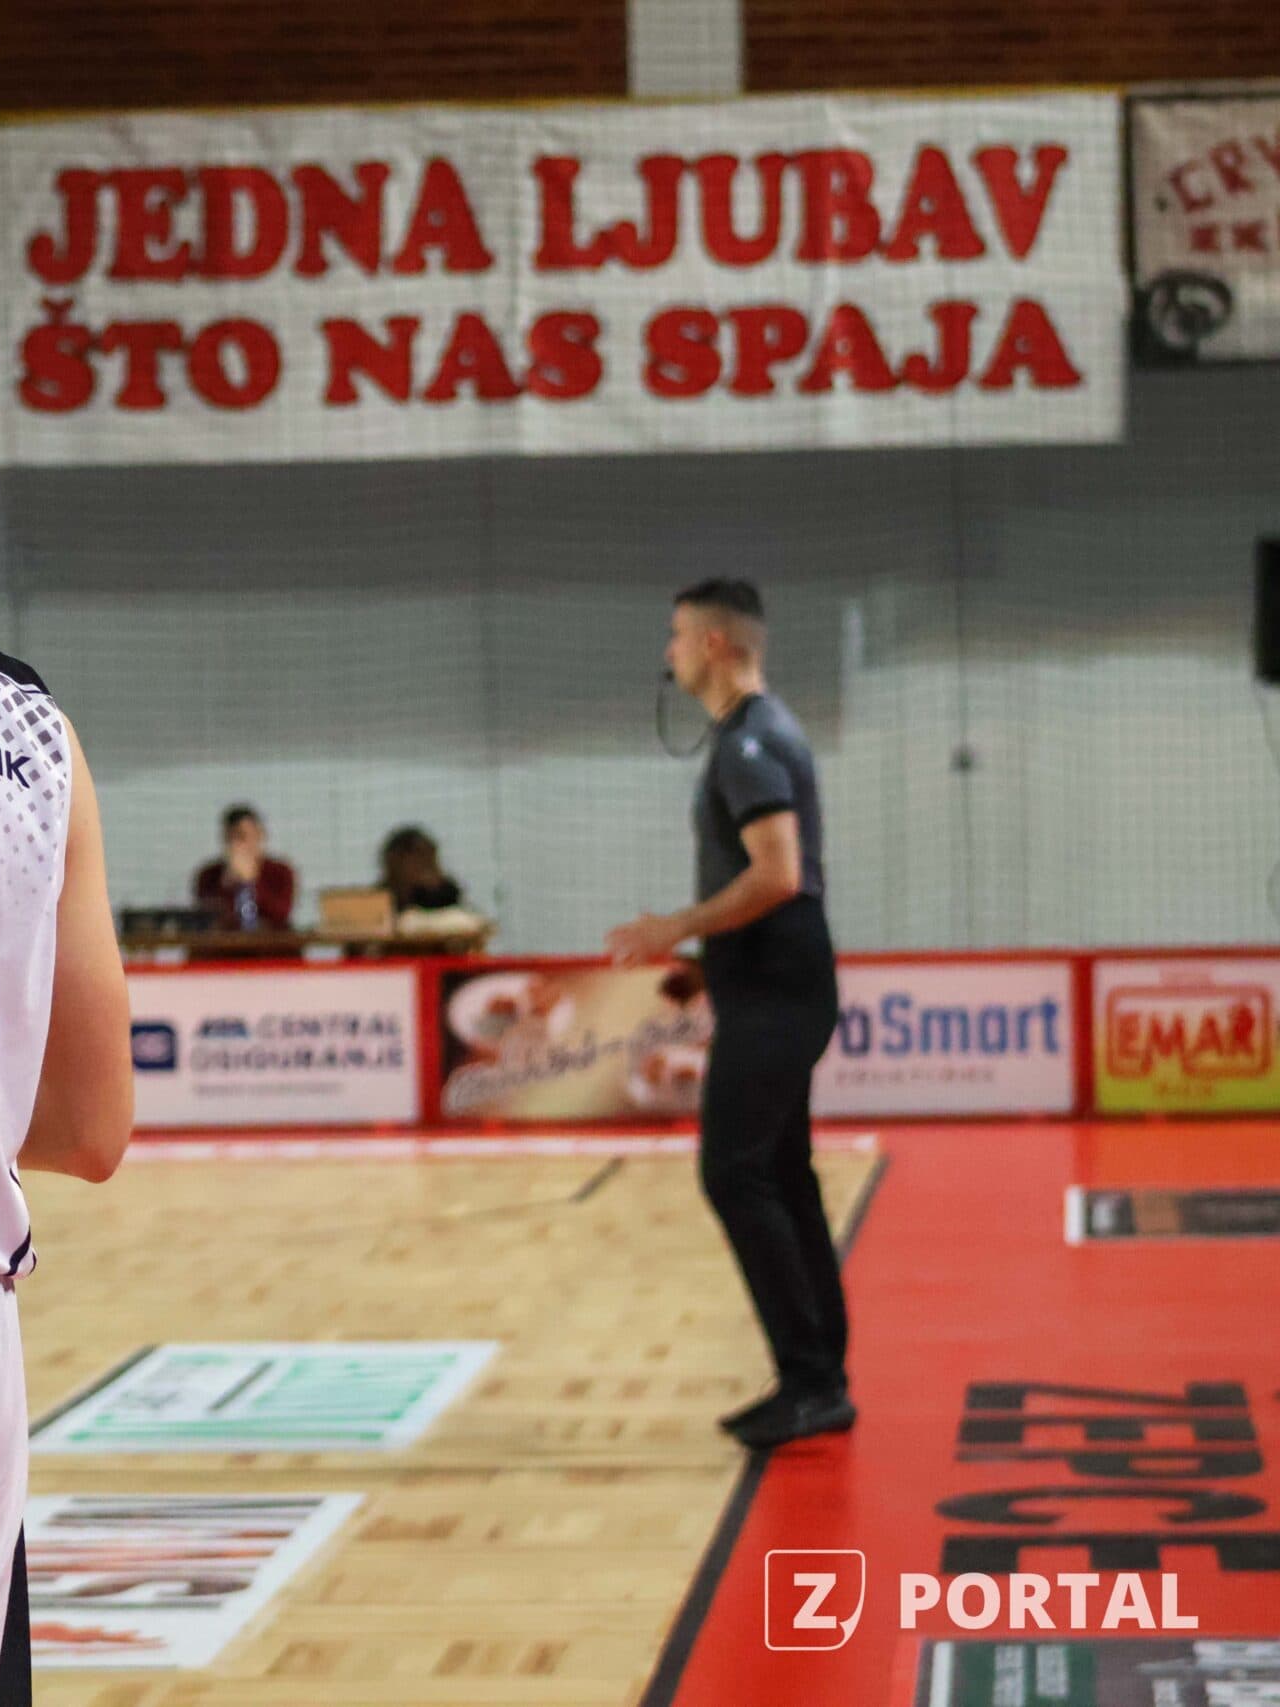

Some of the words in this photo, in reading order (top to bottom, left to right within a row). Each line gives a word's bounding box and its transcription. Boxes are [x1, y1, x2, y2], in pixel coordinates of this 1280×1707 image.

[27, 157, 494, 286] JEDNA
[532, 144, 1069, 273] LJUBAV
[18, 297, 281, 413] ŠTO
[324, 308, 604, 405] NAS
[644, 298, 1084, 398] SPAJA
[837, 990, 1060, 1058] oSmart
